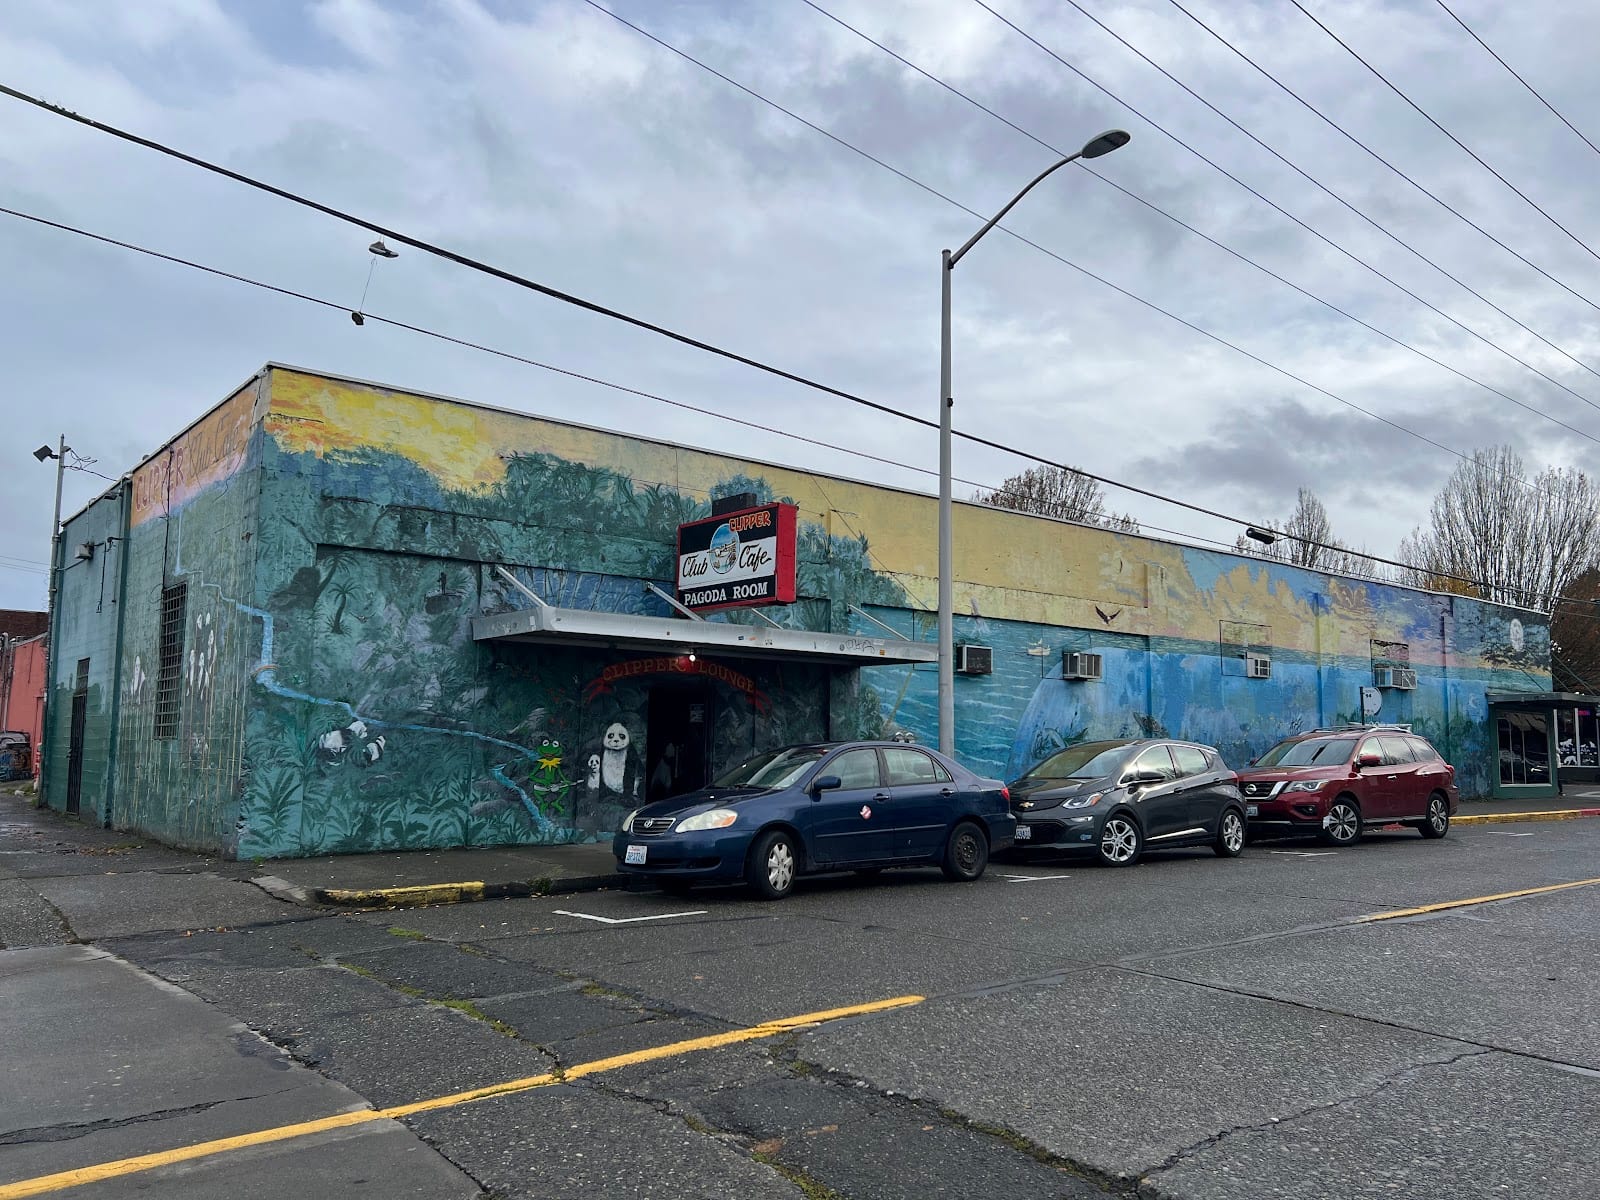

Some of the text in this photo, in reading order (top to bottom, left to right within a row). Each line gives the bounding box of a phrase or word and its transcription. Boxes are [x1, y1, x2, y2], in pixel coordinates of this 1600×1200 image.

[729, 510, 771, 532] CLIPPER
[682, 544, 772, 577] Club Cafe
[684, 581, 768, 606] PAGODA ROOM
[603, 657, 754, 693] CLIPPER LOUNGE
